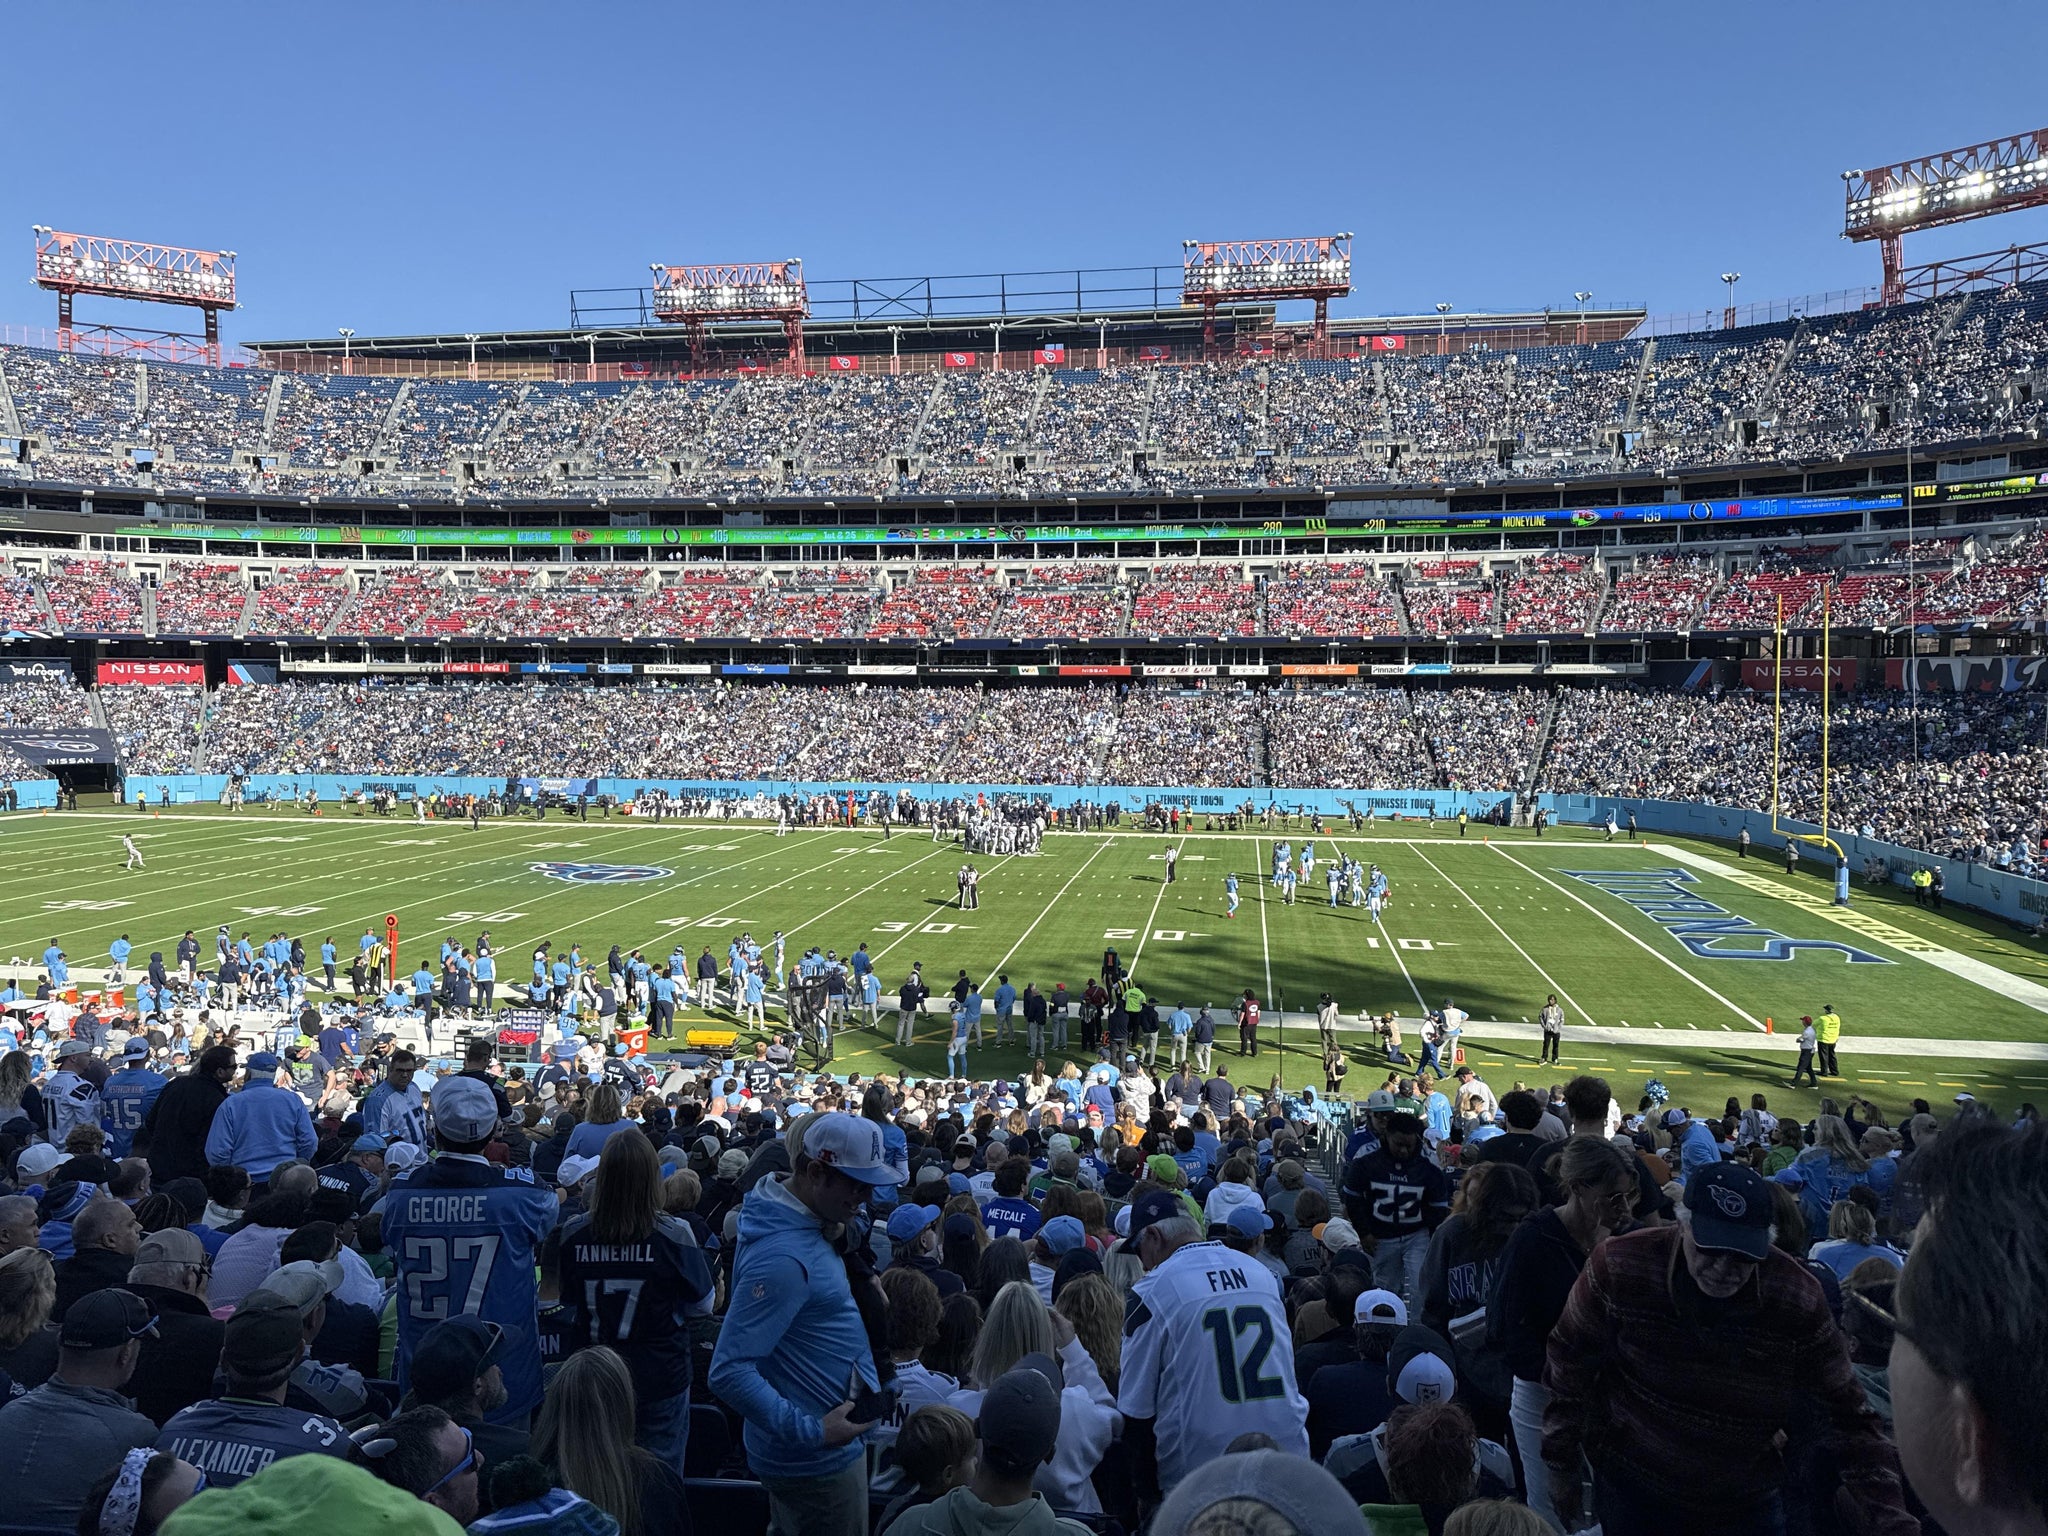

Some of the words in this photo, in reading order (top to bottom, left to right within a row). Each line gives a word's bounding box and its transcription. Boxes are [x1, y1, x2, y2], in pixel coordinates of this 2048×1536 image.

[1502, 515, 1546, 528] MONEYLINE
[1636, 508, 1661, 523] -135
[171, 523, 215, 536] MONEYLINE
[1035, 526, 1070, 538] 15:00
[1075, 528, 1092, 536] 2nd
[1145, 525, 1184, 537] MONEYLINE
[1258, 521, 1282, 535] -280
[1363, 519, 1385, 533] +210
[293, 527, 318, 541] -280
[823, 531, 836, 540] 1st
[937, 529, 945, 539] 3
[973, 529, 981, 539] 3
[28, 664, 65, 680] Kroger
[111, 664, 190, 674] NISSAN
[1755, 666, 1841, 677] NISSAN
[1160, 795, 1198, 805] TENNESSEE
[1367, 798, 1408, 808] TENNESSEE
[1410, 799, 1436, 809] TOUGH
[435, 911, 530, 923] 50
[655, 916, 741, 928] 40
[1546, 867, 1901, 966] TITANS
[871, 921, 960, 934] 30
[1103, 928, 1187, 942] 20
[1840, 917, 1944, 953] CLEATS
[1366, 937, 1435, 951] 10
[562, 1018, 576, 1029] 98
[277, 1033, 294, 1049] 28
[630, 1034, 643, 1049] G
[750, 1075, 770, 1094] 22
[111, 1099, 142, 1130] 15
[408, 1196, 487, 1223] GEORGE
[1370, 1181, 1425, 1224] 22
[987, 1207, 1027, 1224] METCALF
[575, 1244, 655, 1263] TANNEHILL
[405, 1236, 500, 1320] 27
[1207, 1267, 1248, 1293] FAN
[584, 1278, 647, 1344] 17
[539, 1333, 560, 1355] AN
[1203, 1305, 1285, 1404] 12
[881, 1402, 910, 1428] AN
[171, 1437, 276, 1477] ALEXANDER
